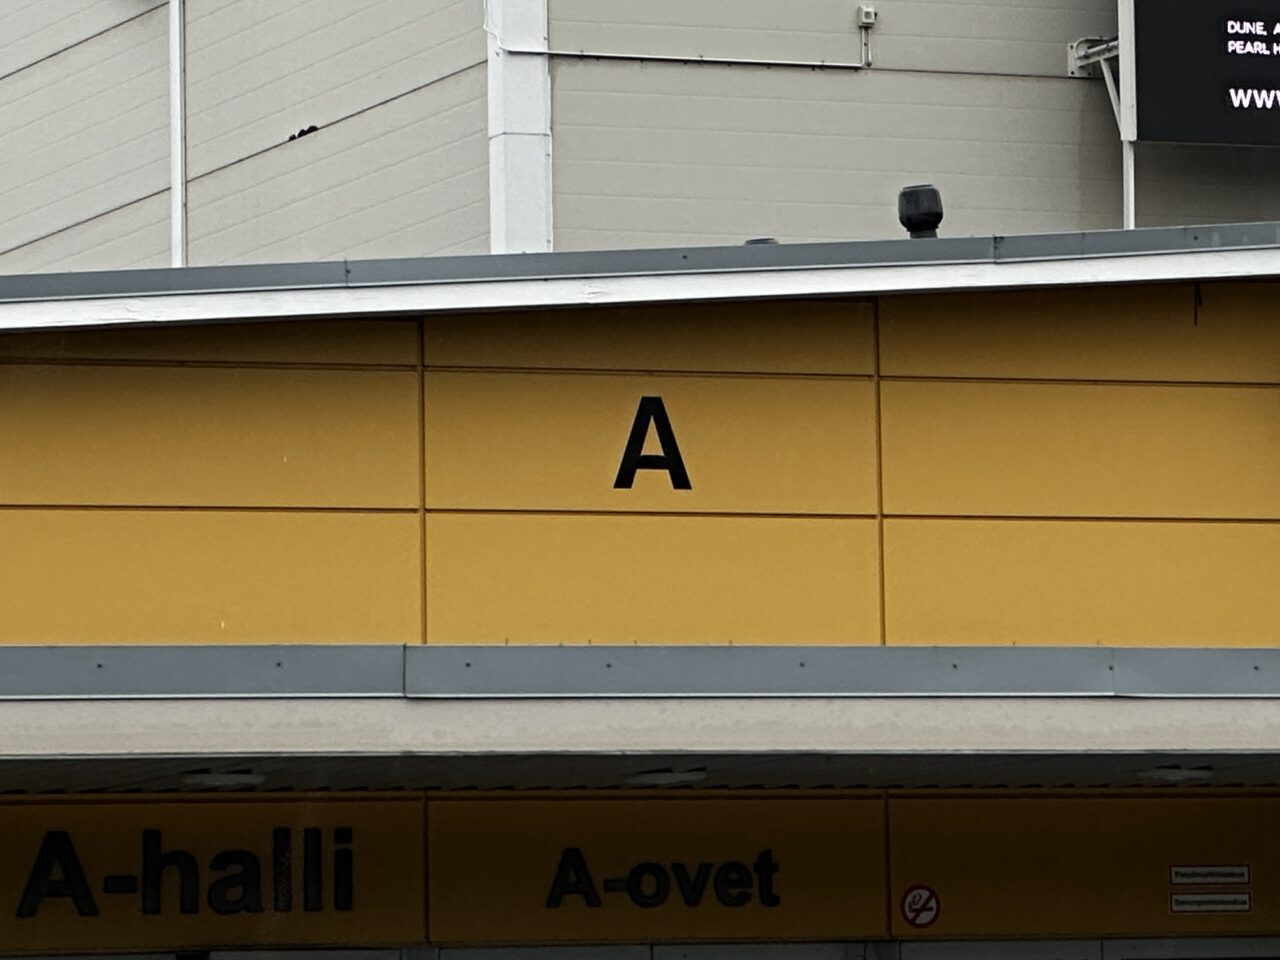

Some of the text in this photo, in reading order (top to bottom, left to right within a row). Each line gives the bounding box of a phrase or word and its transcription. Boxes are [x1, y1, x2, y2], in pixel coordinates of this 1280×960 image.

[1227, 40, 1271, 56] PEARL
[613, 396, 692, 490] A
[15, 826, 354, 918] A-halli
[545, 846, 780, 908] A-ovet
